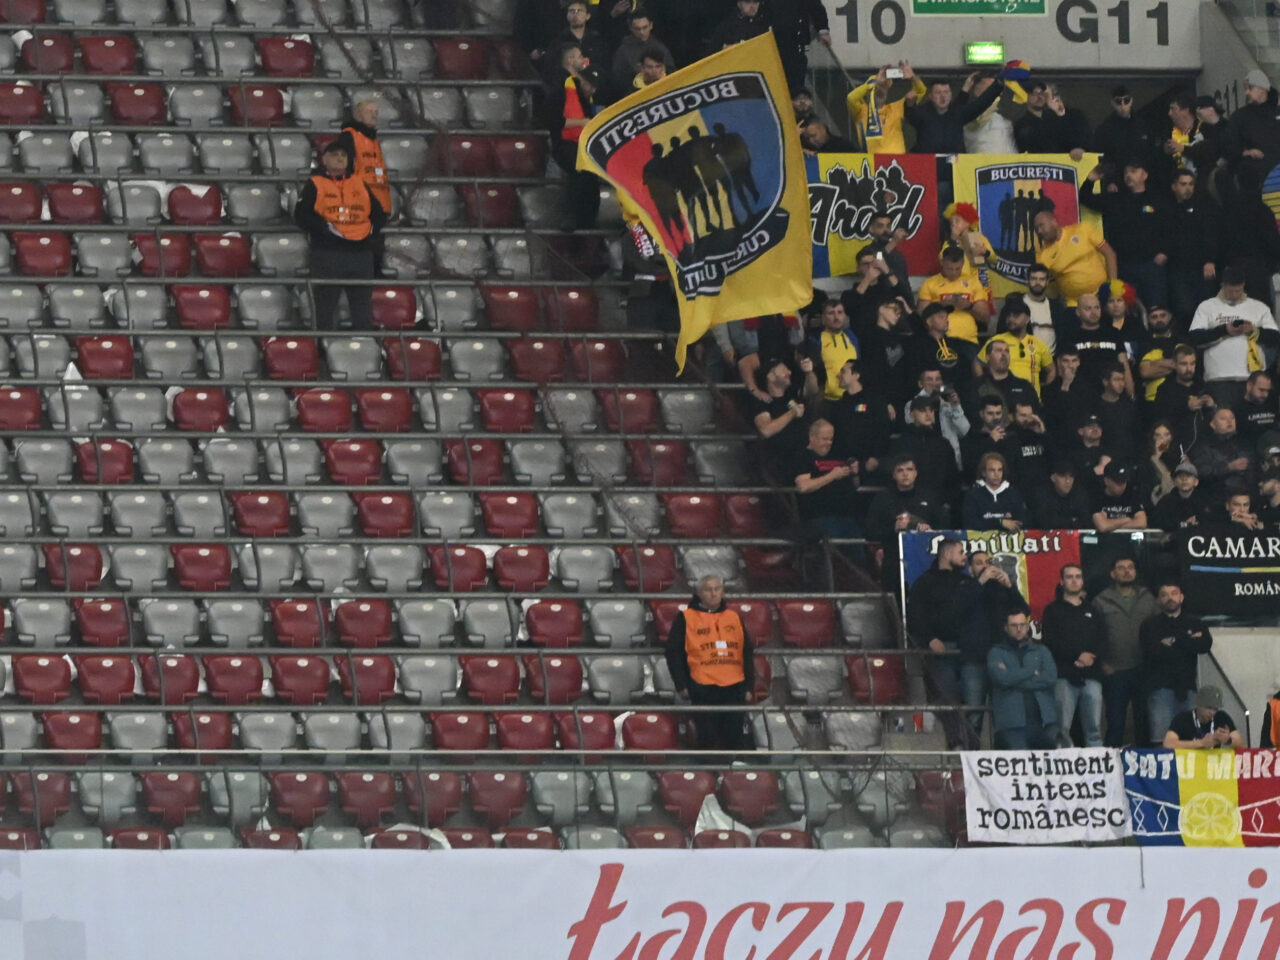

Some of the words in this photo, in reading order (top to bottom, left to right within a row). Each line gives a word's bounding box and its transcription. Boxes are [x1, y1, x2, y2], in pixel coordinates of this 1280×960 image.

[835, 0, 906, 45] 10
[990, 166, 1064, 181] BUCUREȘTI
[806, 183, 925, 246] Arad
[977, 750, 1115, 777] sentiment
[1123, 750, 1196, 780] SATU
[1010, 778, 1107, 802] intens
[976, 803, 1127, 830] românesc
[928, 897, 1125, 960] nas
